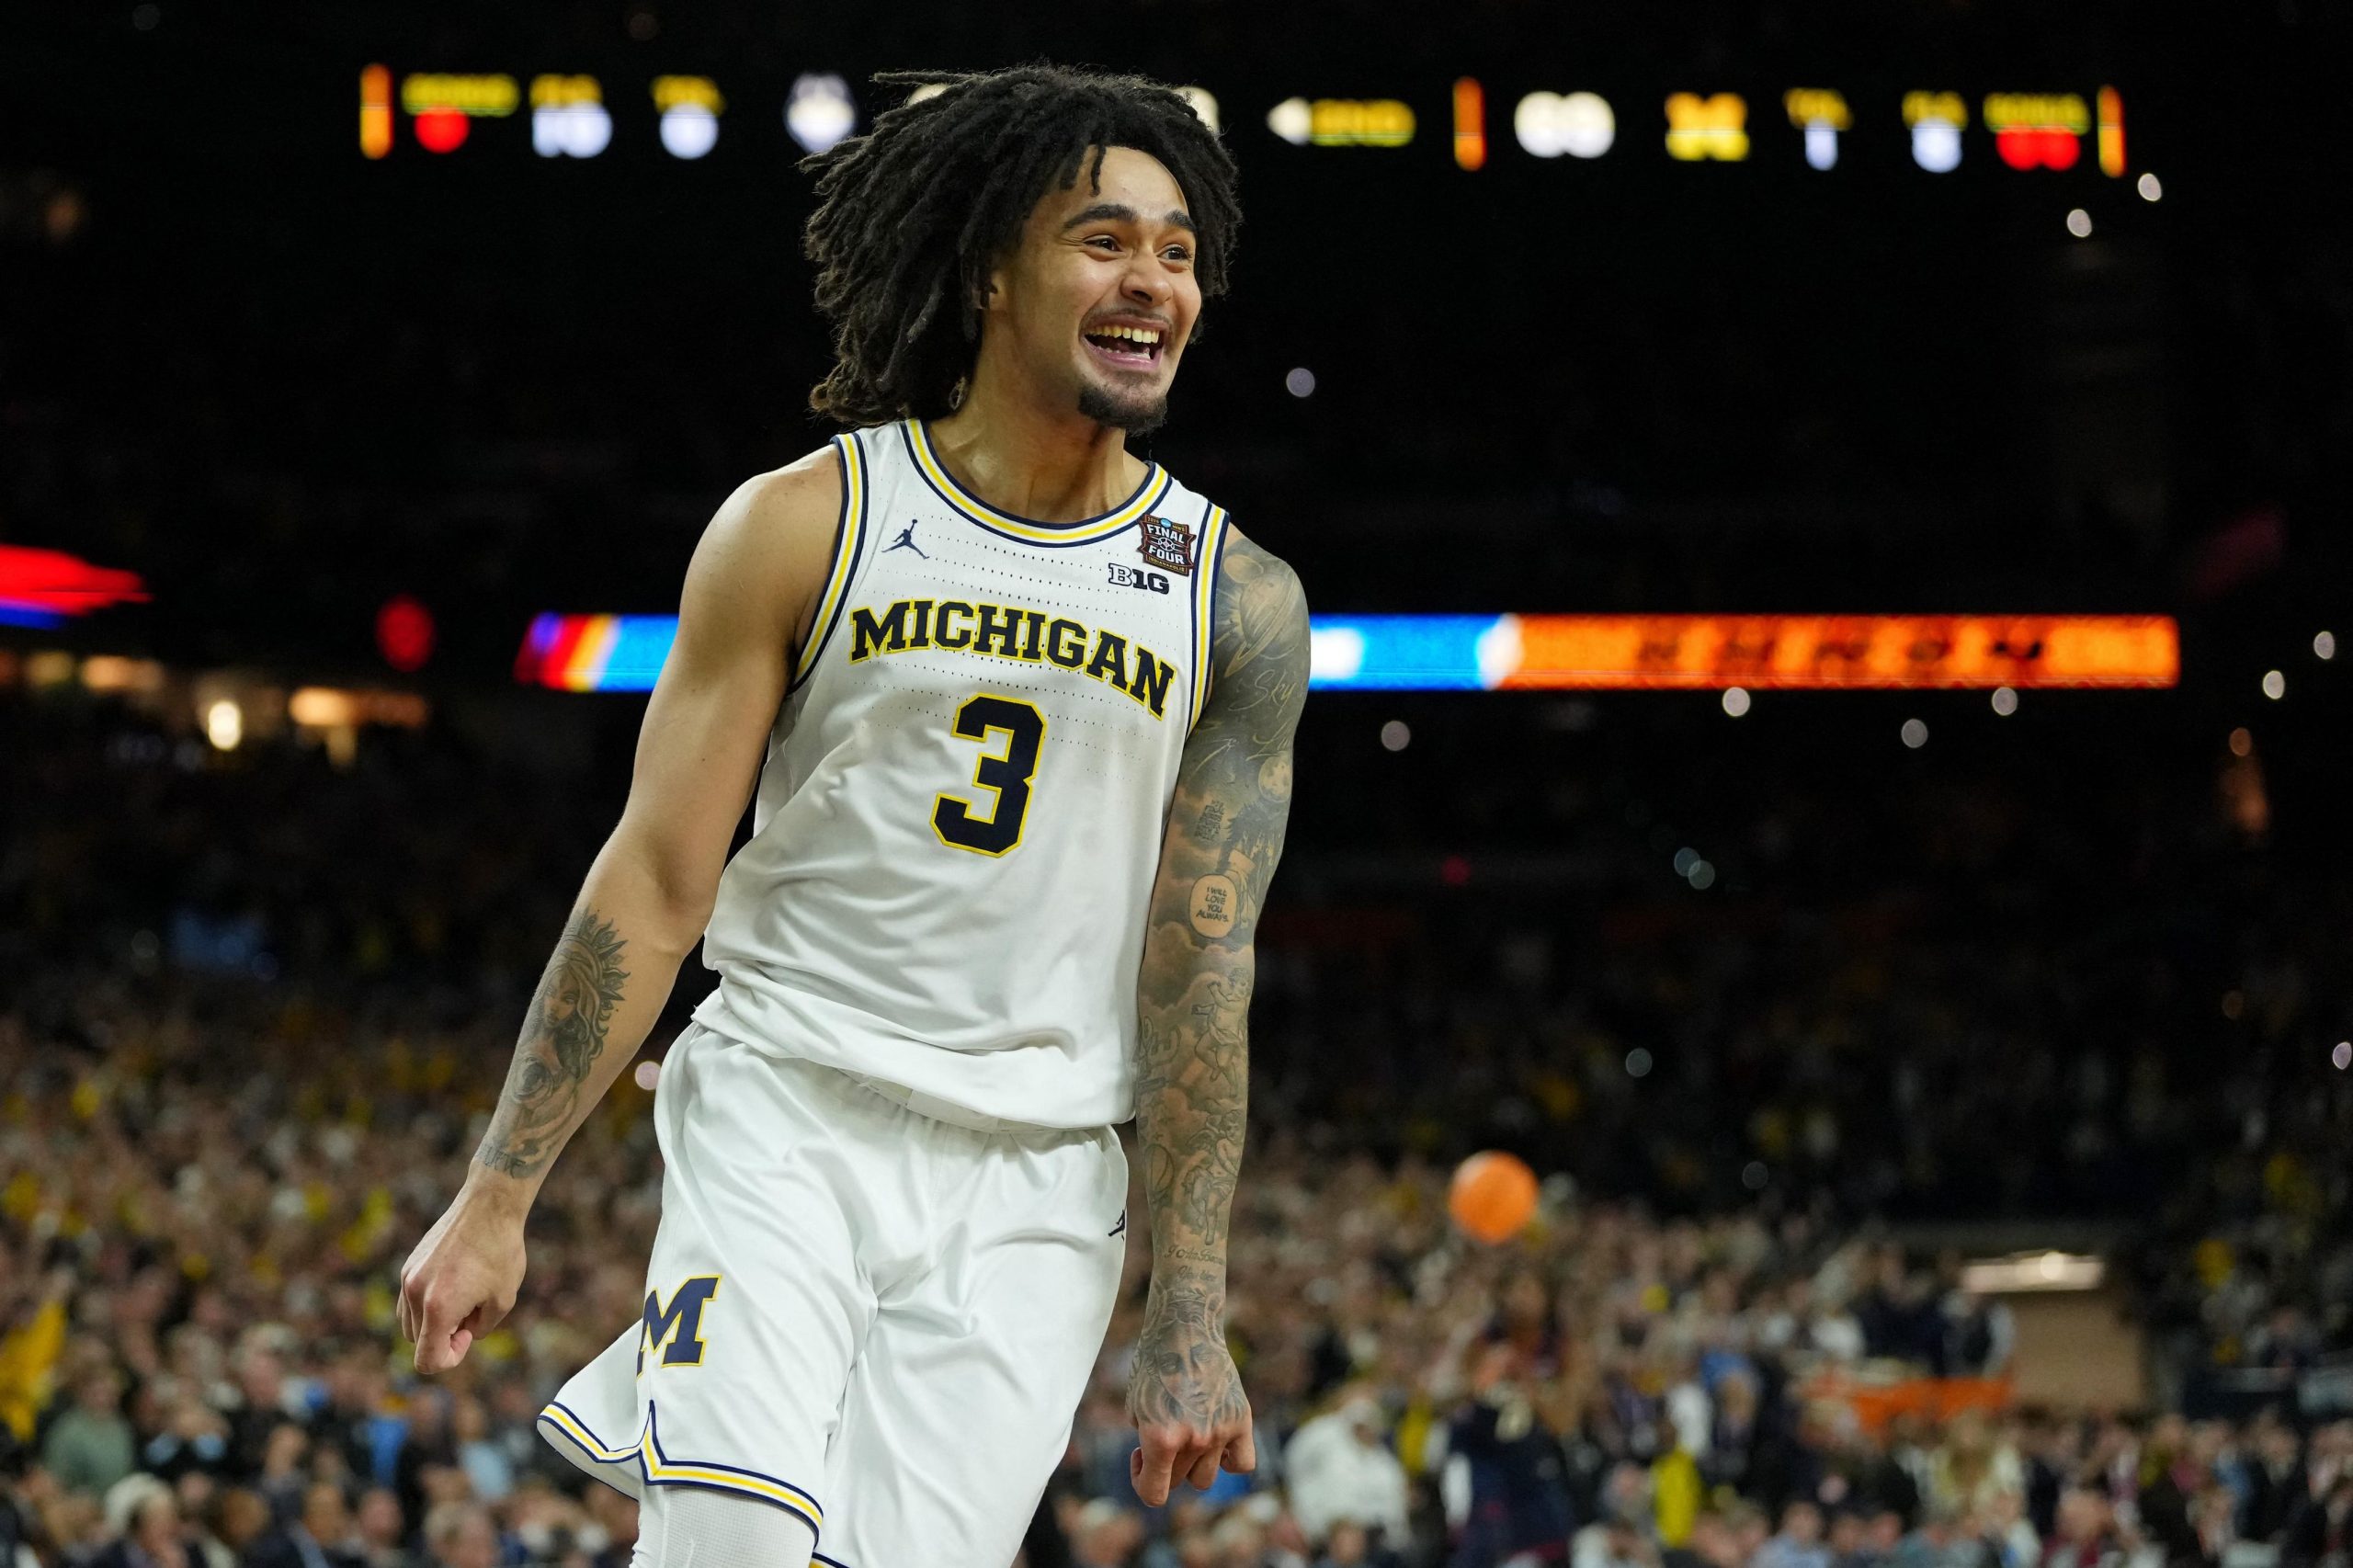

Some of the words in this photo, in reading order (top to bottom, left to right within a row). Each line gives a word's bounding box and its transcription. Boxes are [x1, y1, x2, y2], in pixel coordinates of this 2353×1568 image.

[1146, 524, 1185, 543] FINAL
[1148, 544, 1186, 565] FOUR
[1148, 556, 1186, 572] INDIANAPOLIS
[849, 597, 1177, 722] MICHIGAN
[929, 691, 1048, 858] 3
[1205, 894, 1225, 905] LOVE
[1211, 887, 1227, 897] WILL
[1207, 903, 1222, 913] YOU
[635, 1274, 722, 1381] M
